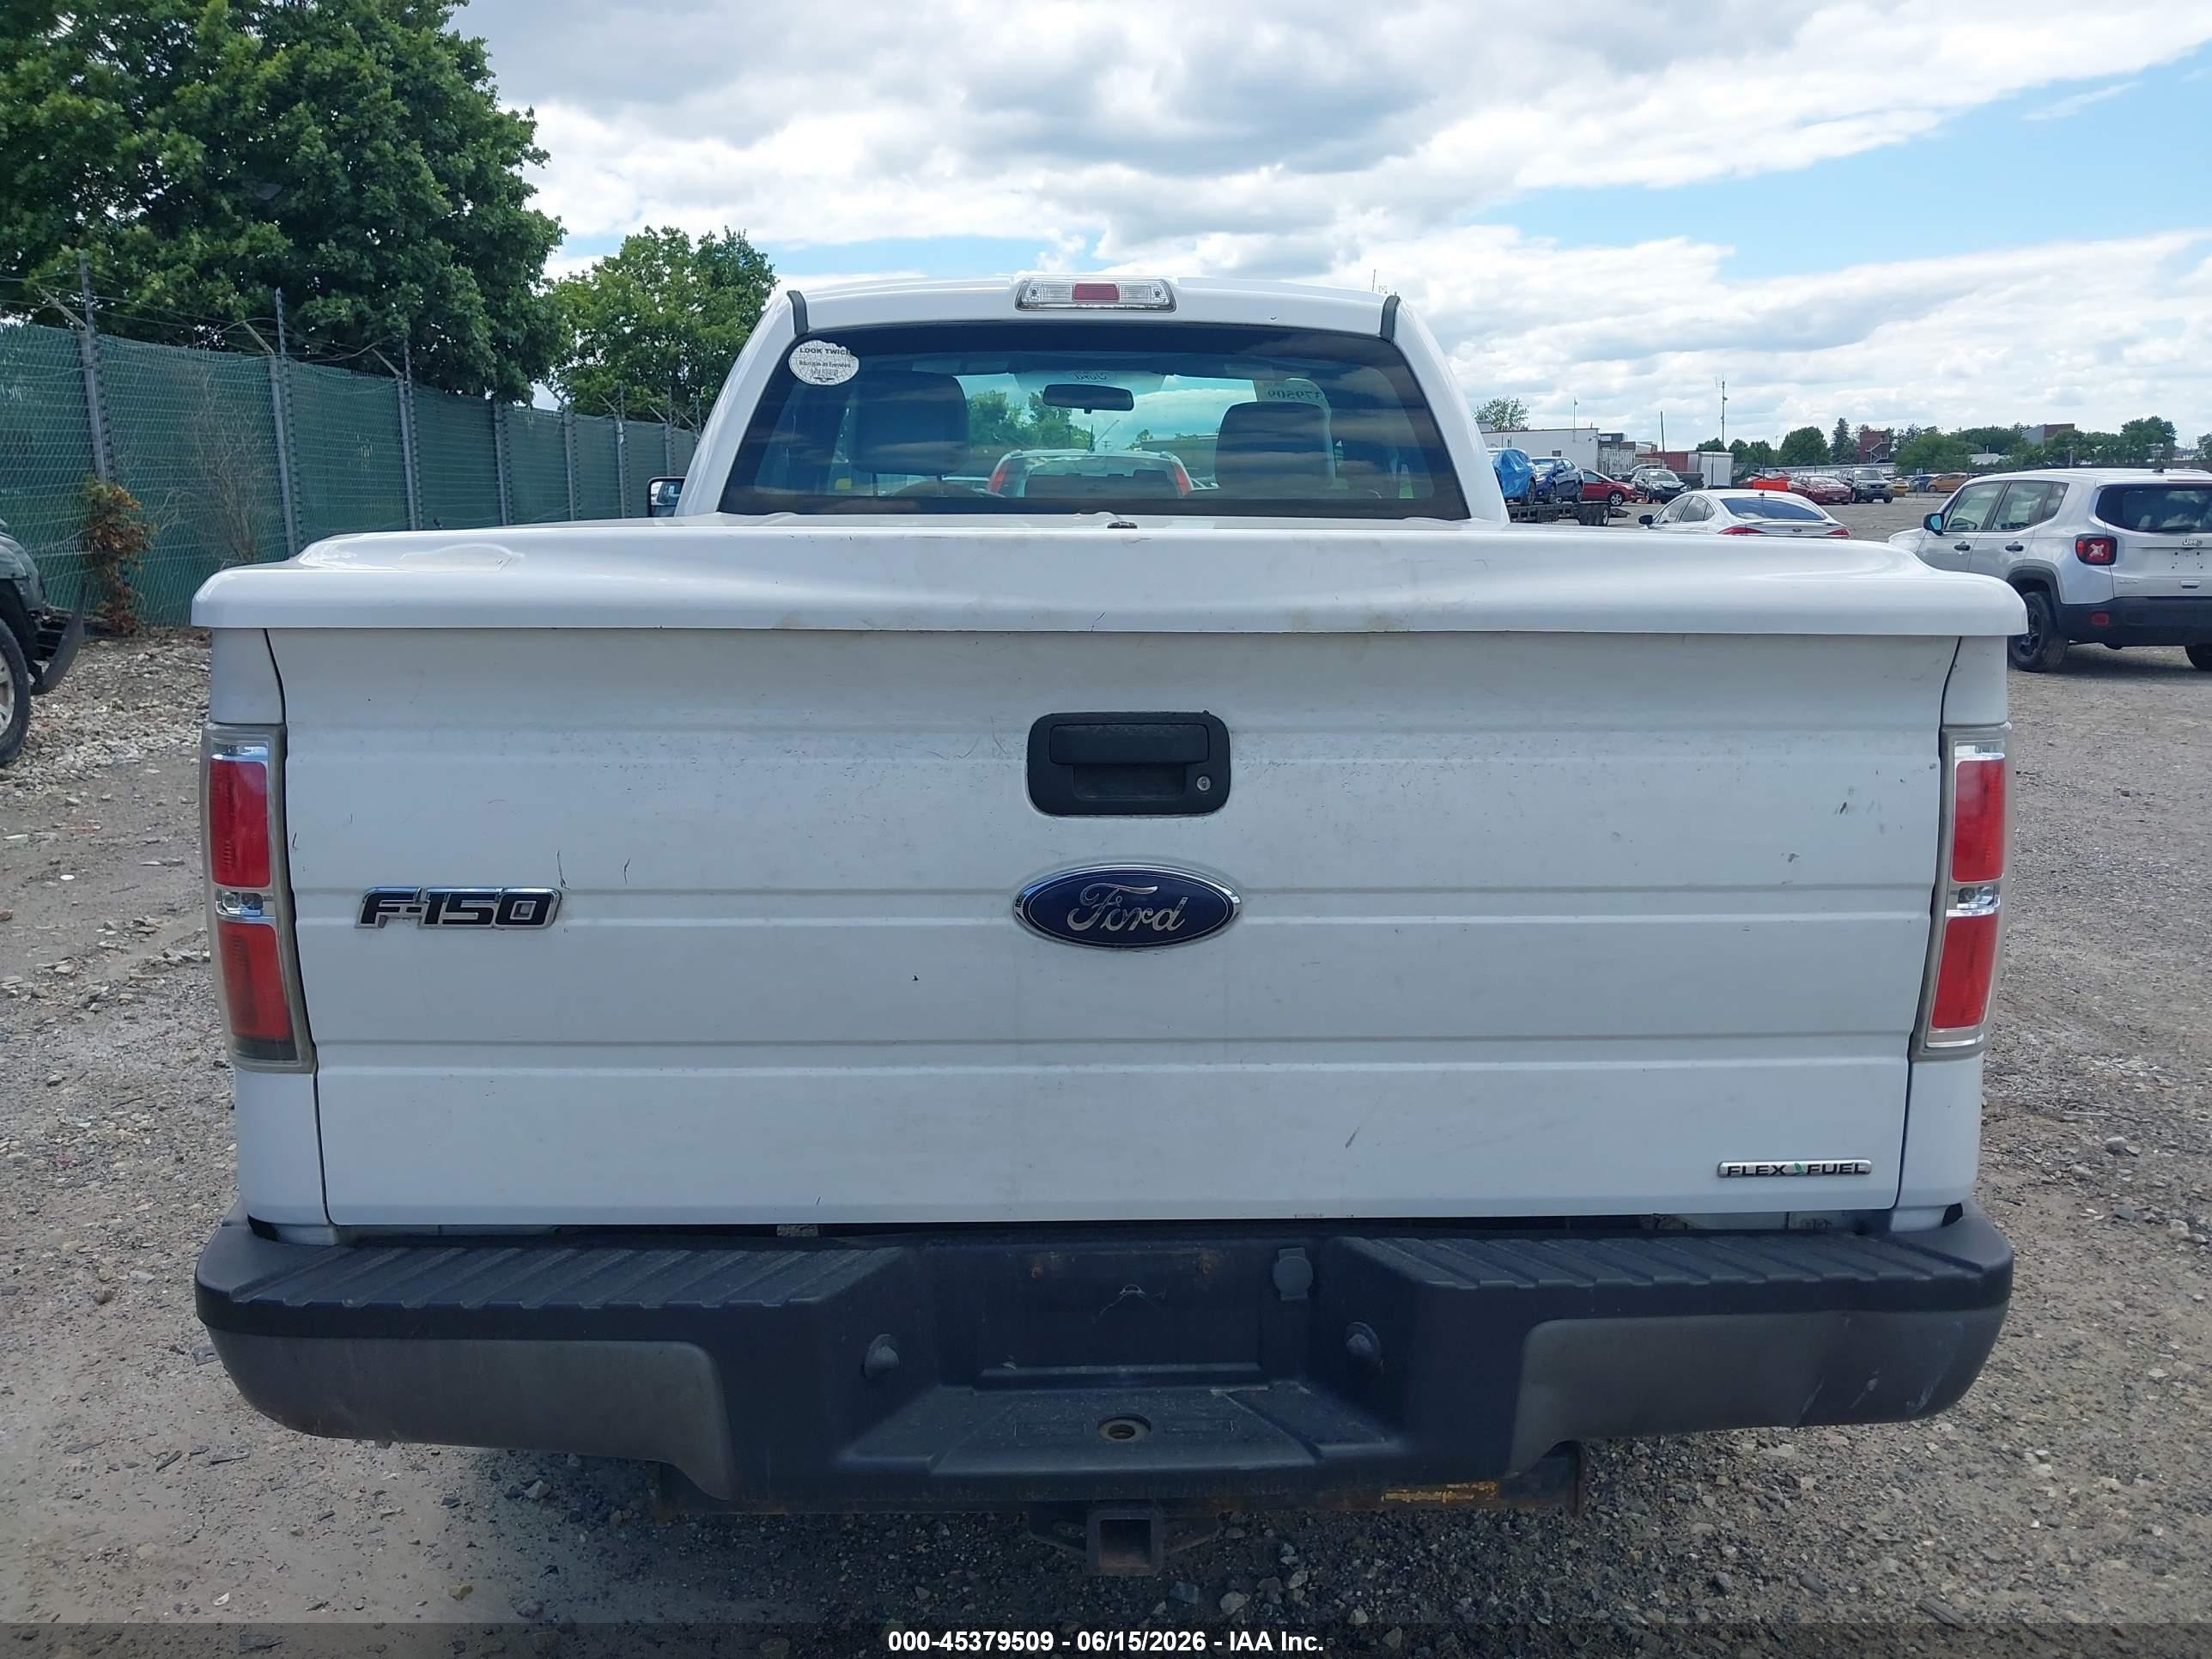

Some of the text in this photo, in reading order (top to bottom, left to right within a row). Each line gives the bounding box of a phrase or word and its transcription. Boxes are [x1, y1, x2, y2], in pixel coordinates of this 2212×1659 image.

[356, 887, 562, 929] F-150
[1066, 883, 1189, 932] Ford
[1727, 1163, 1868, 1176] FLEX FUEL
